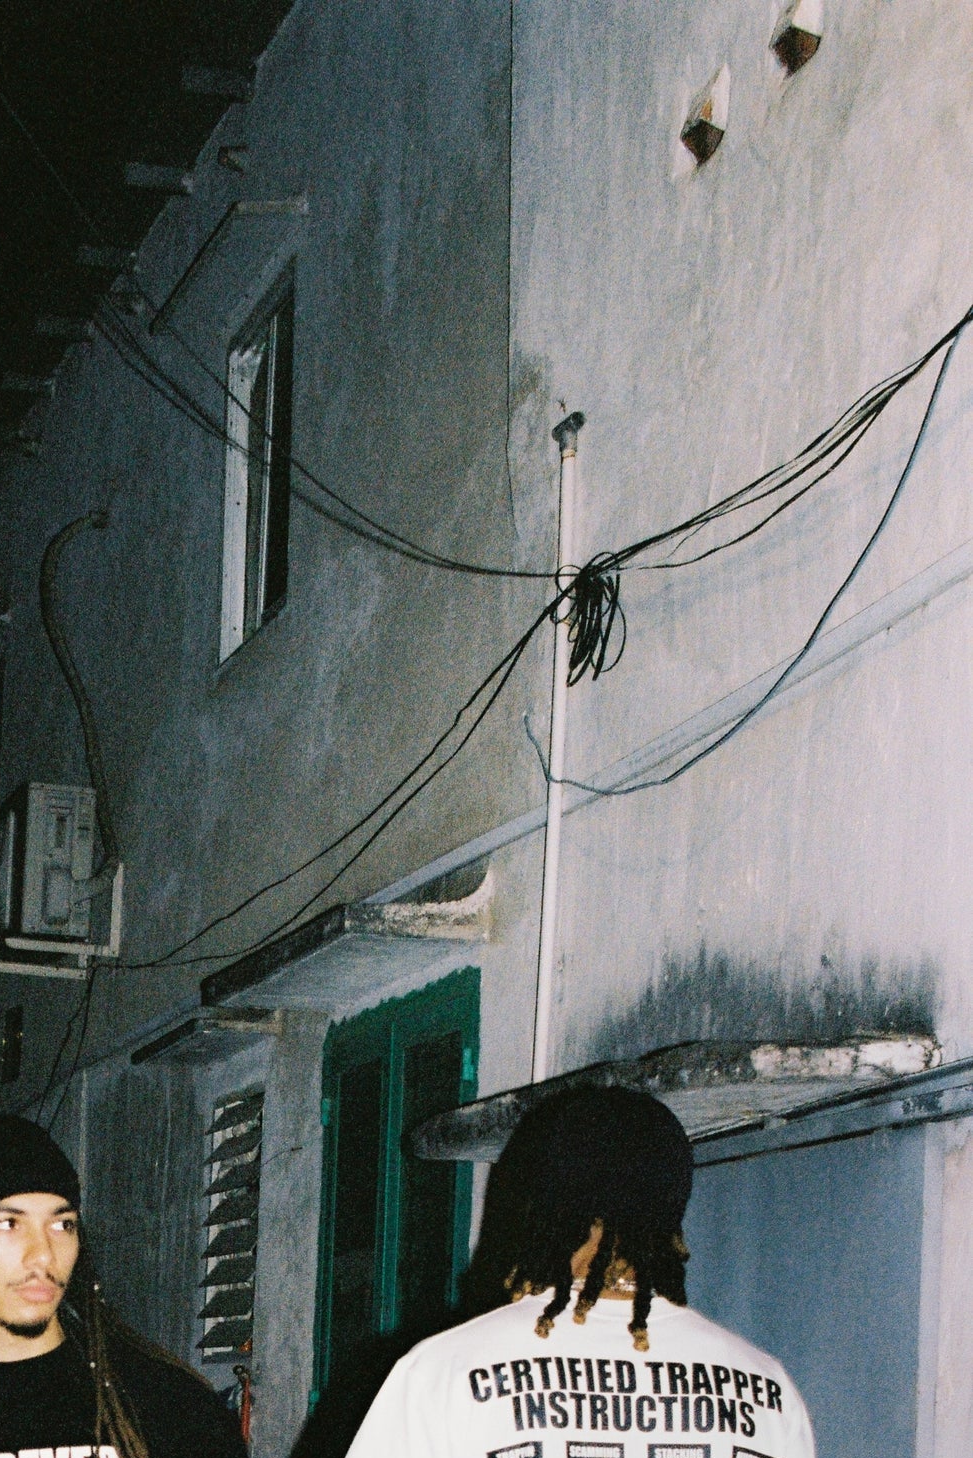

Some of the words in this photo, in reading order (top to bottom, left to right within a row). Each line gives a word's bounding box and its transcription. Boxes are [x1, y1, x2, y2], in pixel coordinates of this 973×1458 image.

[468, 1356, 637, 1403] CERTIFIED
[644, 1361, 782, 1413] TRAPPER
[512, 1391, 756, 1438] INSTRUCTIONS
